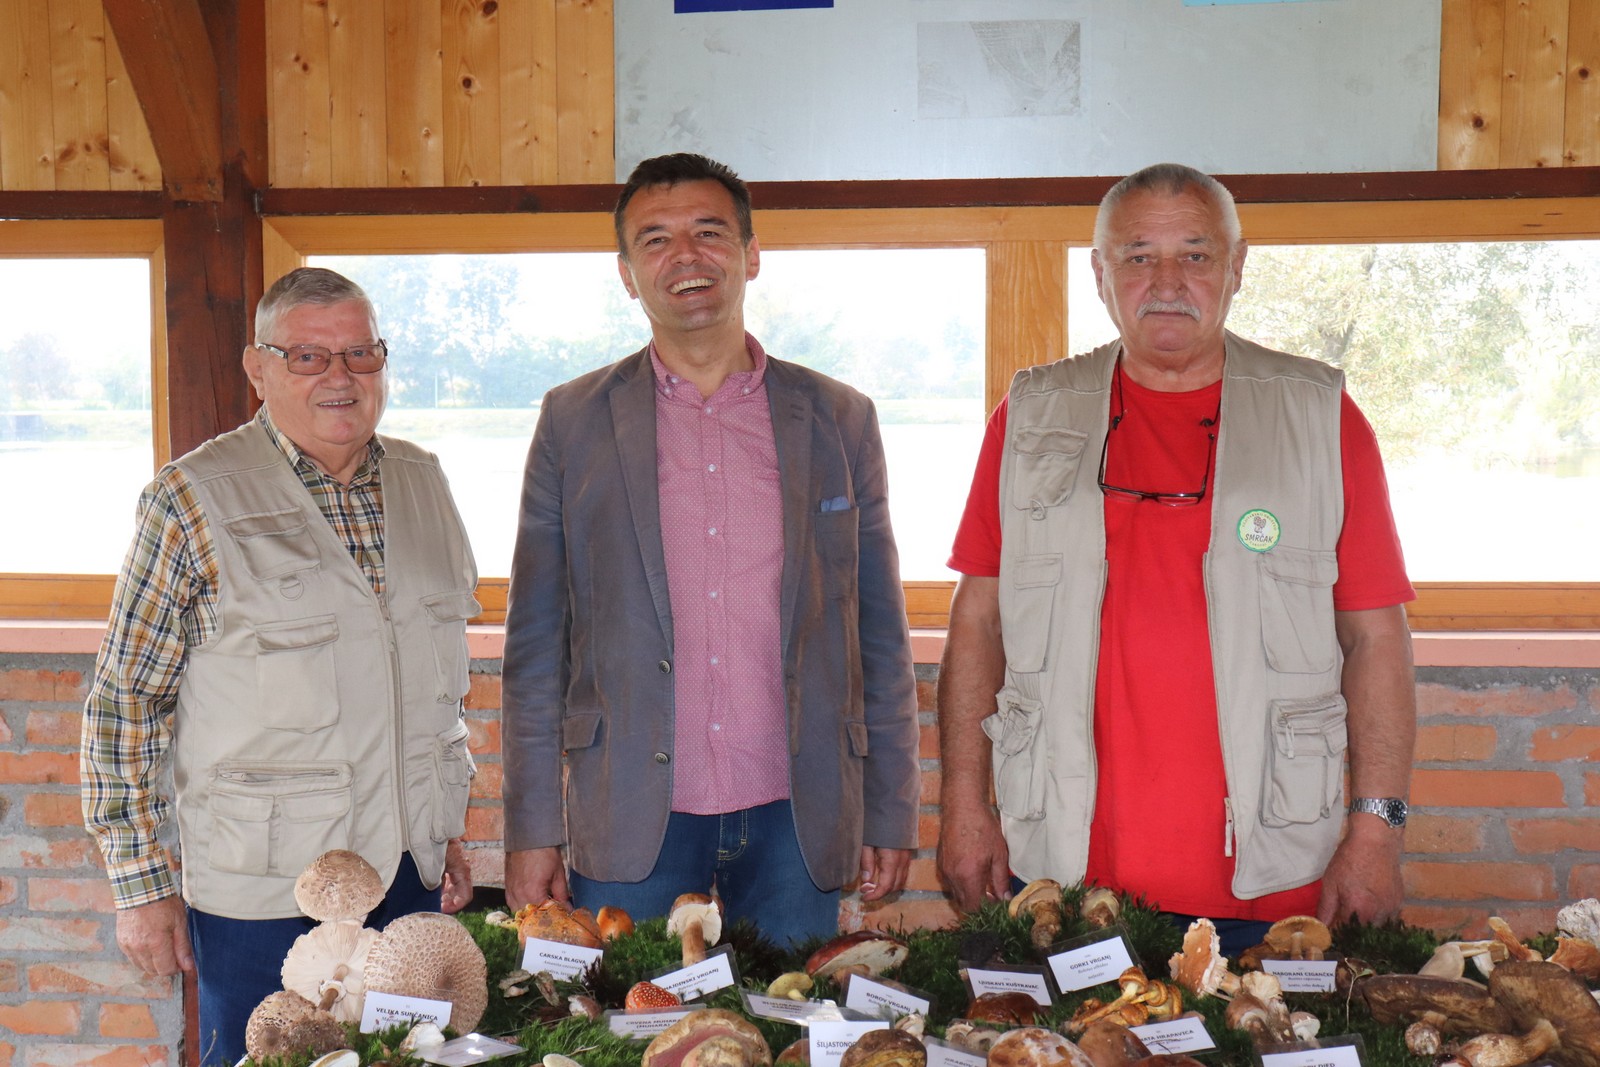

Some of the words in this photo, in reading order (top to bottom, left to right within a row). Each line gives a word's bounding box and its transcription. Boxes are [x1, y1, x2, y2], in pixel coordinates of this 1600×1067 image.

[1245, 533, 1273, 543] SMRČAK
[539, 952, 562, 961] CARSKA
[564, 957, 587, 965] BLAGVA
[1070, 960, 1089, 970] GORKI
[1090, 955, 1111, 965] VRGANJ
[697, 968, 719, 979] VRGANJ
[866, 992, 887, 1003] BOROV
[888, 1000, 911, 1012] VRGANJ
[376, 1007, 399, 1016] VELIKA
[401, 1011, 438, 1020] SUNČANICA
[1157, 1030, 1194, 1040] HRAPAVICA
